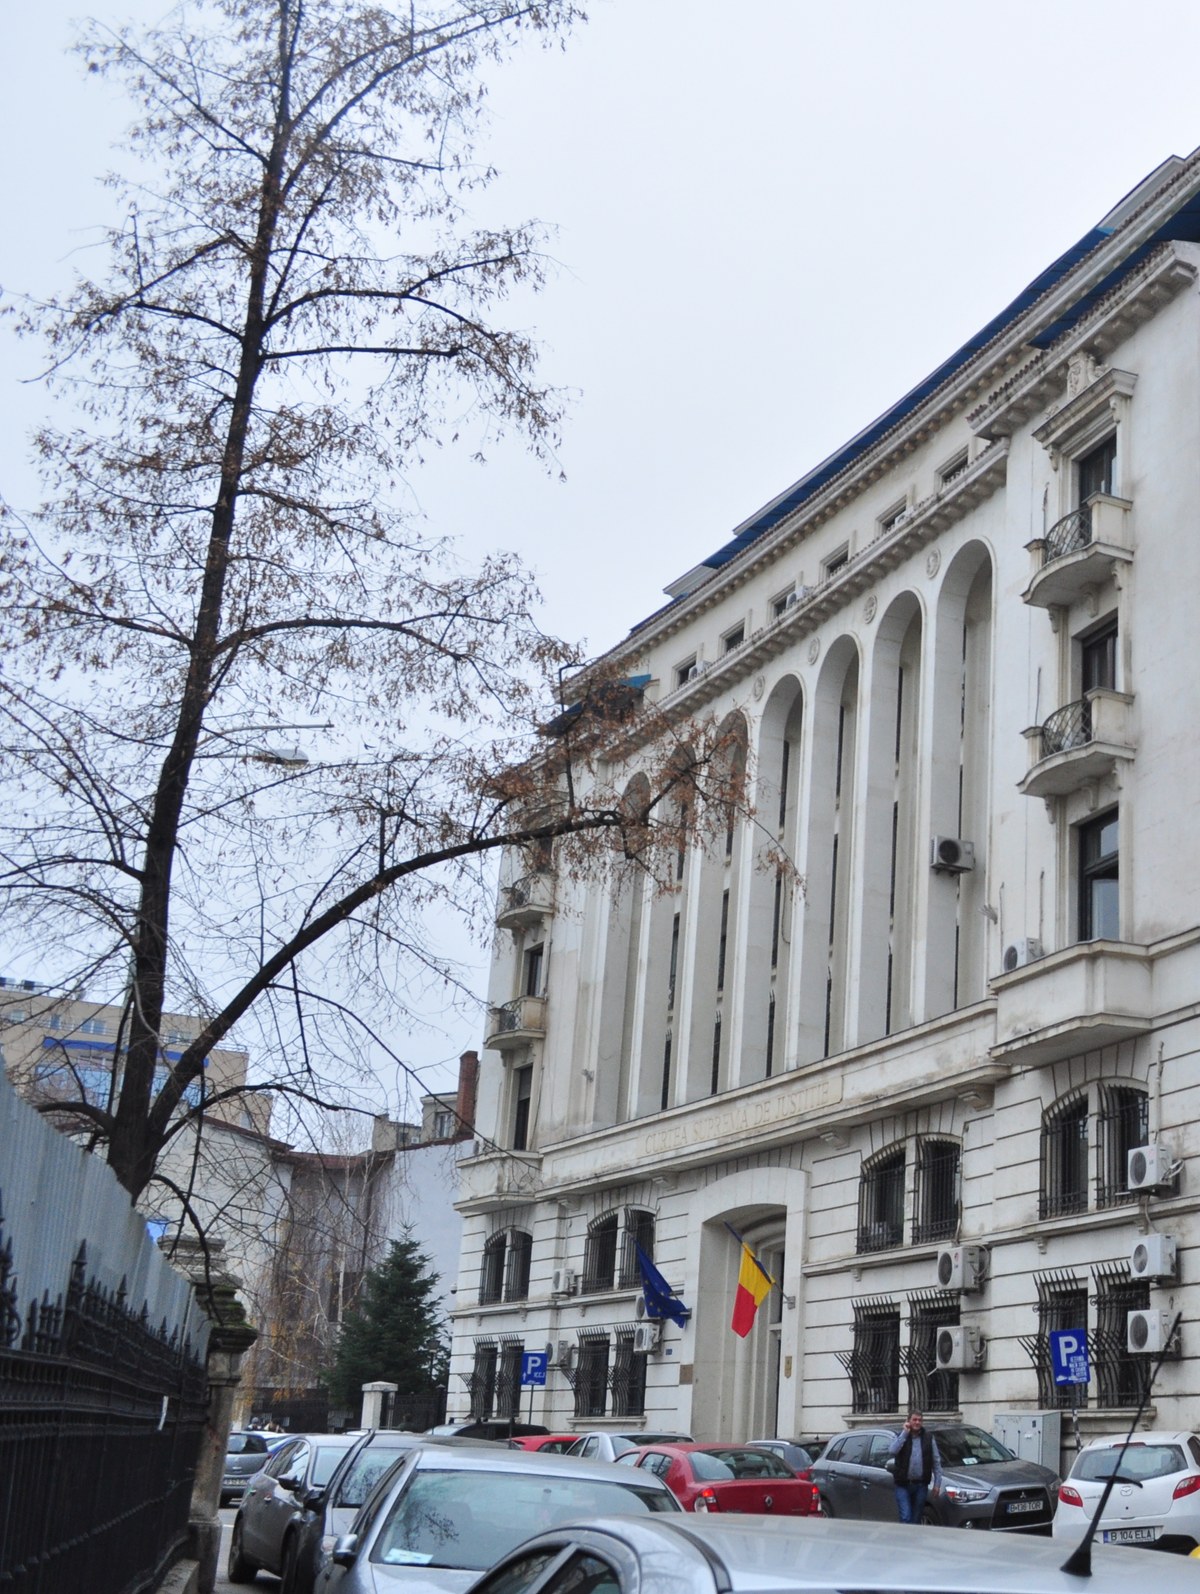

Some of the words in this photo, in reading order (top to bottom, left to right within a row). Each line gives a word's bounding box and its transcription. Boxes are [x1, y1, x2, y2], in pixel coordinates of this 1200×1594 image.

[645, 1126, 688, 1154] CURTEA
[754, 1101, 770, 1125] DE
[1059, 1336, 1078, 1367] P
[527, 1356, 541, 1375] P
[1110, 1531, 1117, 1541] B
[1120, 1530, 1133, 1540] 104
[1135, 1529, 1151, 1539] ELA
